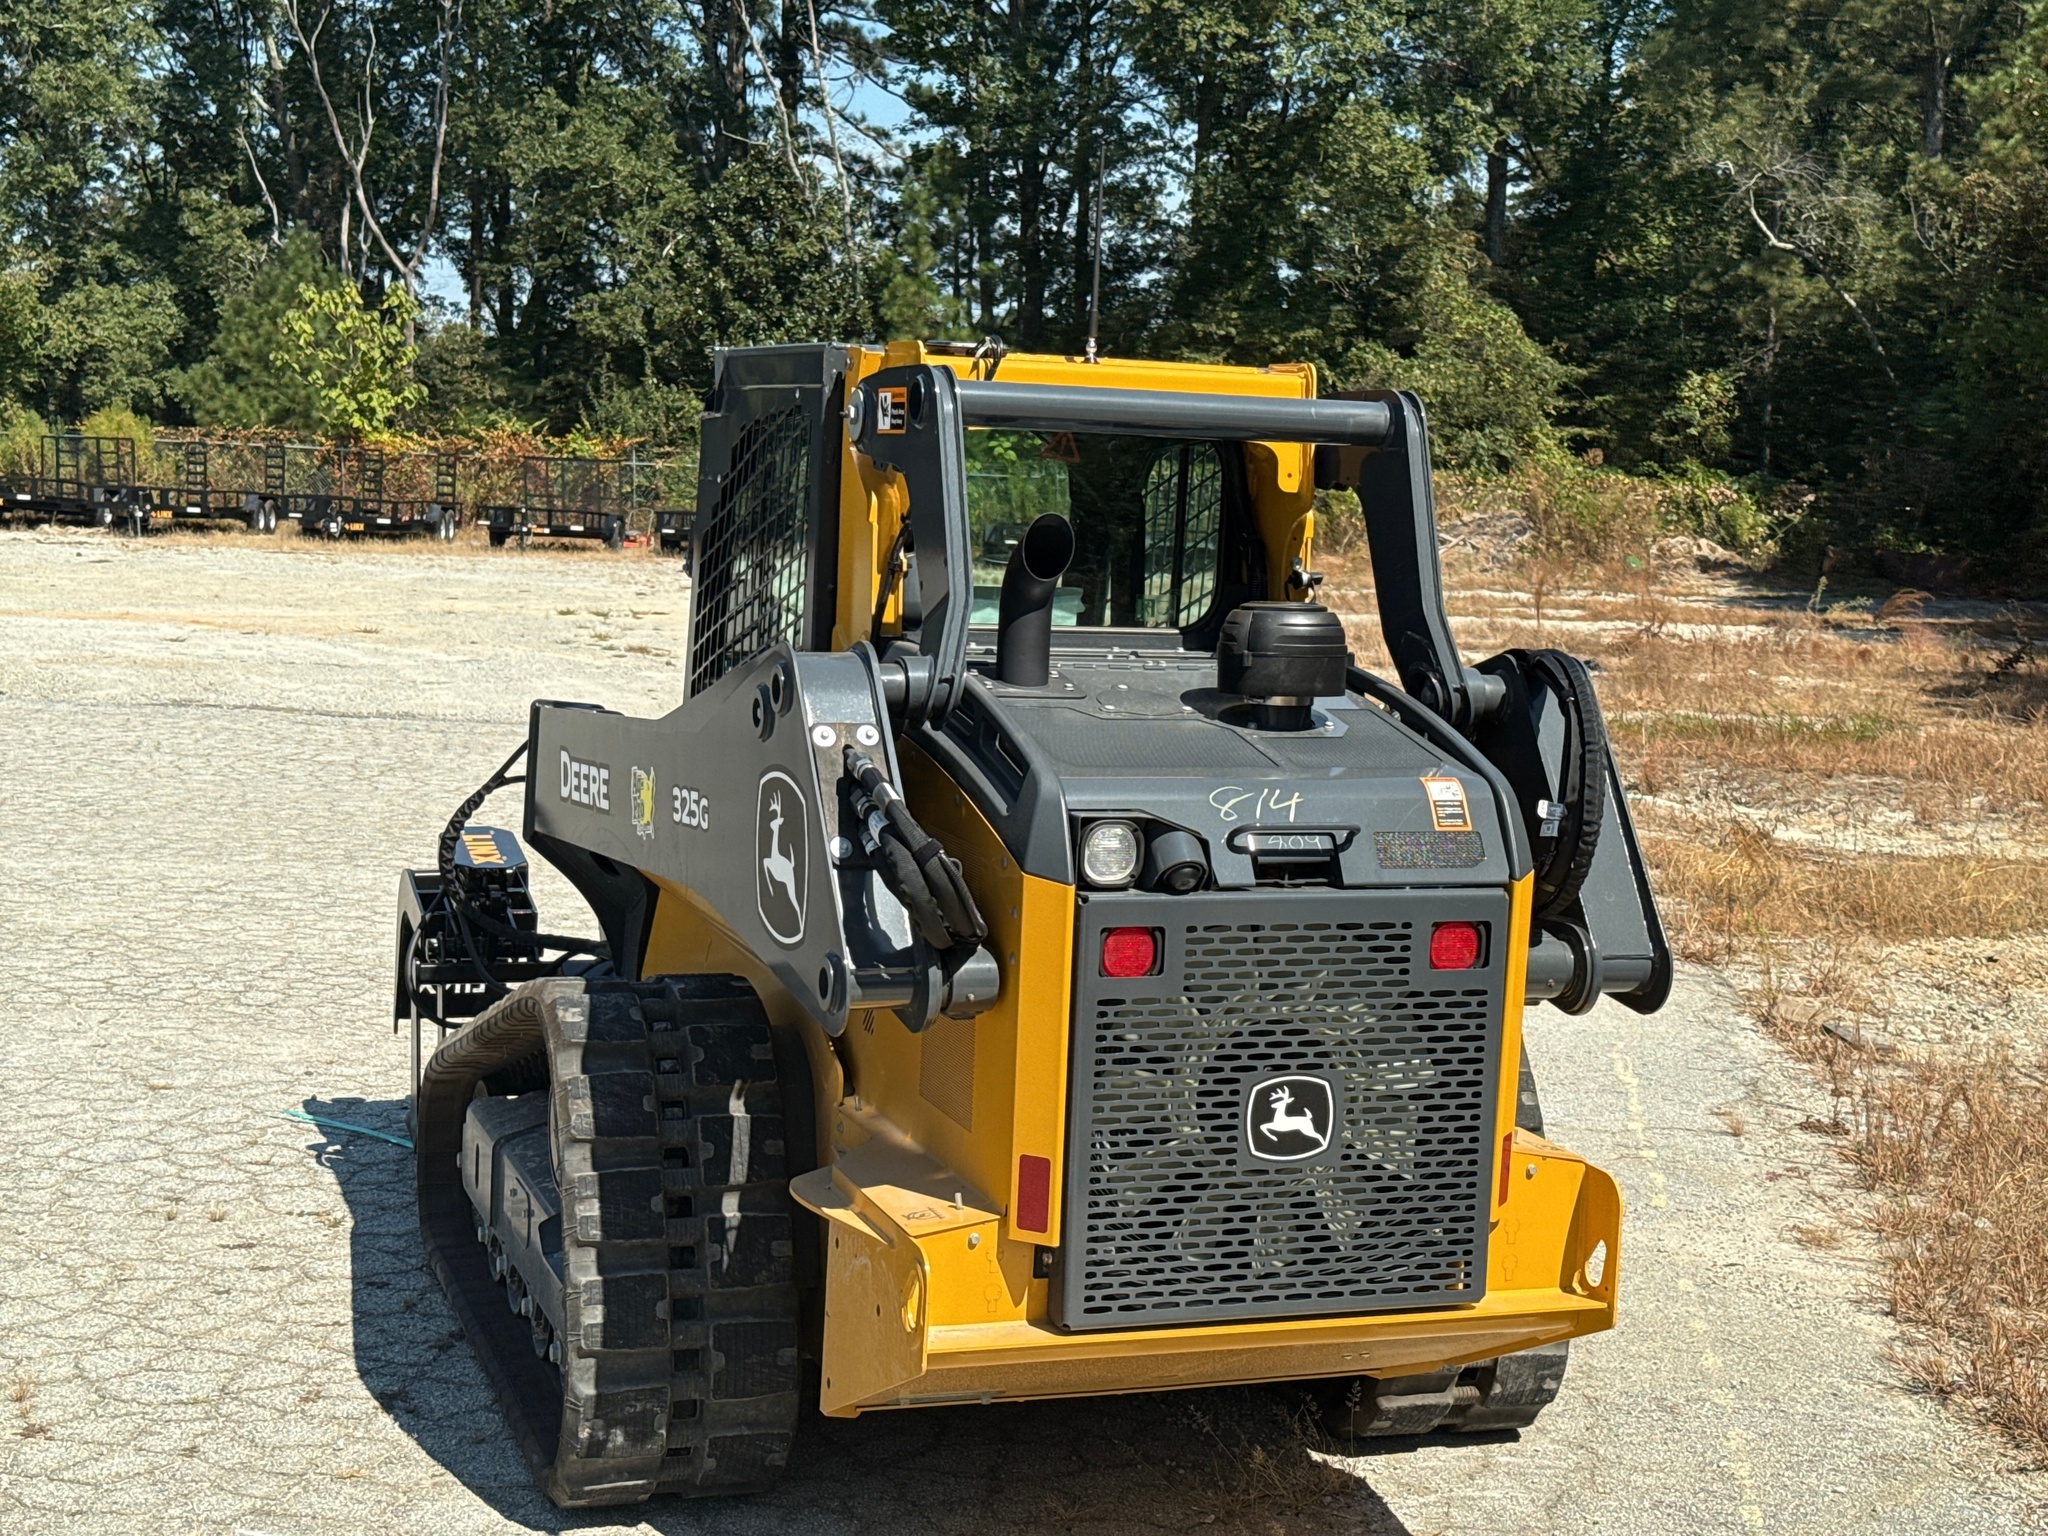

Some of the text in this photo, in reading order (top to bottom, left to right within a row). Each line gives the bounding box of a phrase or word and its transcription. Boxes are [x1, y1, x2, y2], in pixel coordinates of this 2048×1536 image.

[560, 750, 610, 810] DEERE
[672, 786, 709, 830] 325G
[1209, 786, 1304, 822] 814
[462, 834, 505, 865] LINX
